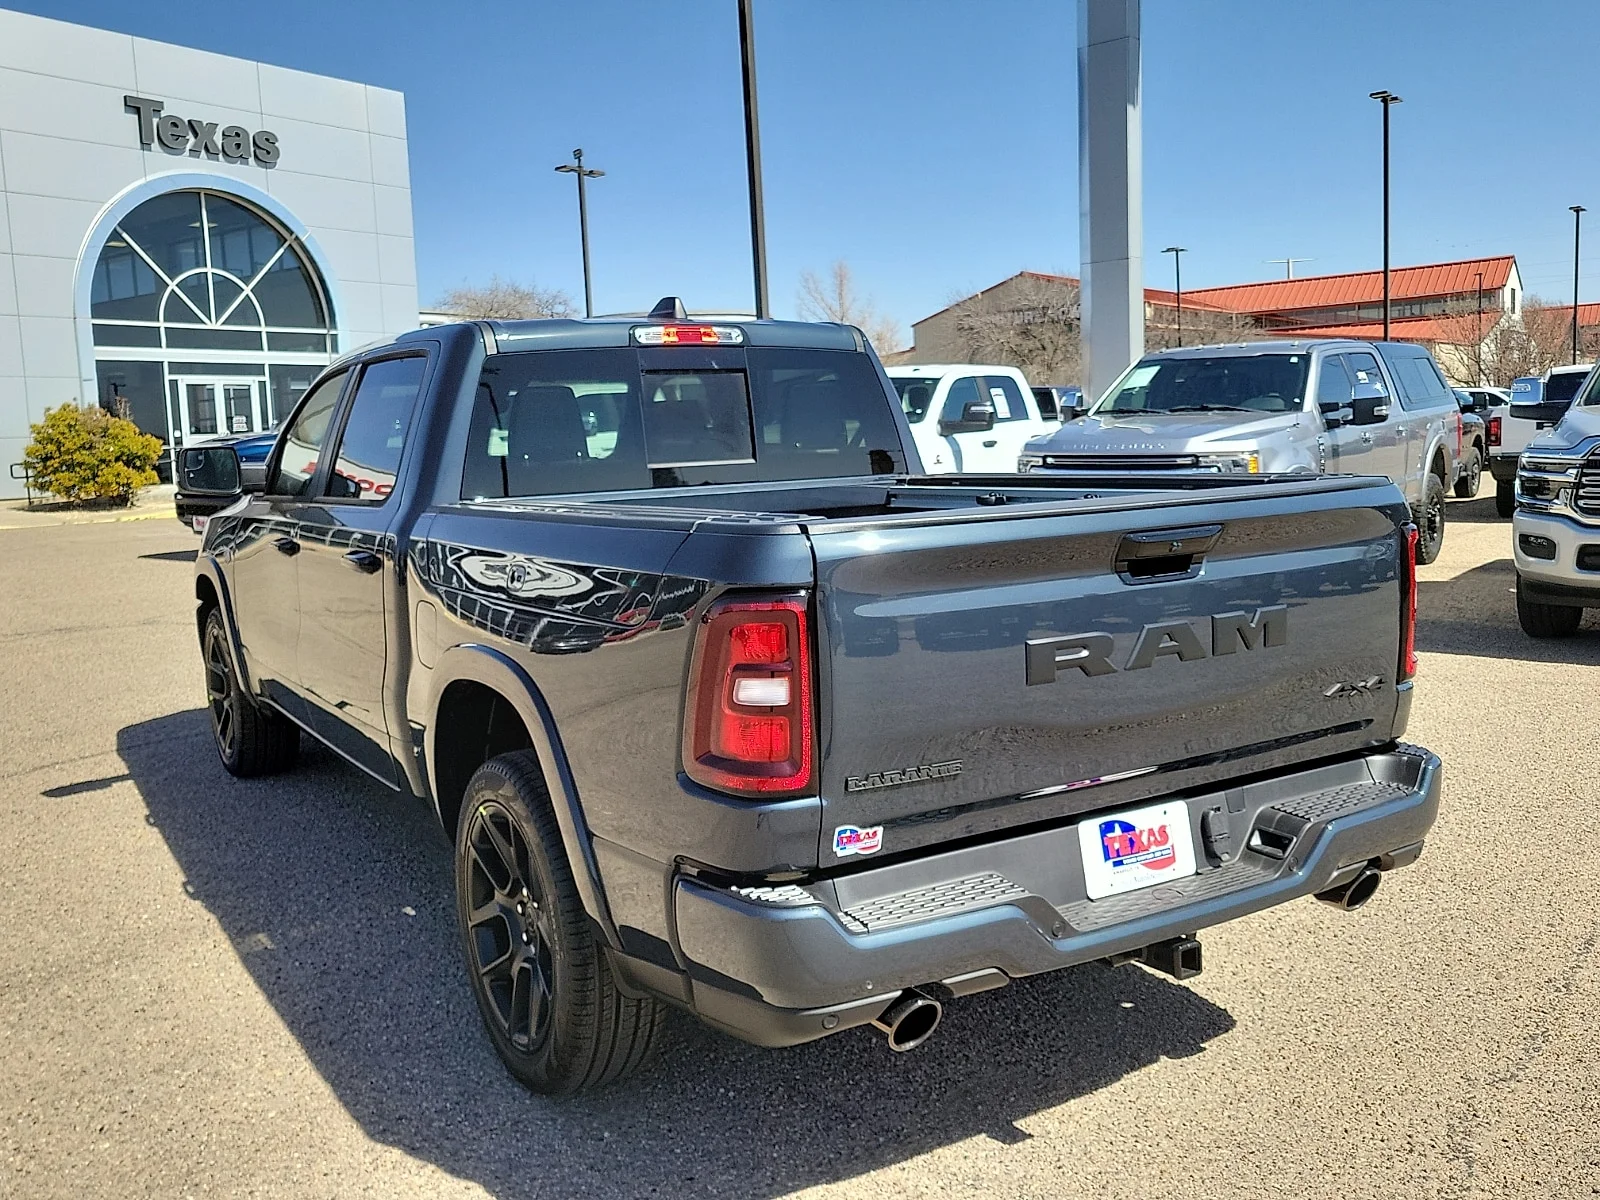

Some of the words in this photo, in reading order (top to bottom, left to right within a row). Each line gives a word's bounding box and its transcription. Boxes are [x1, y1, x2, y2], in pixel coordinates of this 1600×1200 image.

[123, 94, 280, 165] Texas
[1025, 604, 1287, 686] RAM
[837, 830, 879, 846] TEXAS
[1103, 825, 1169, 859] TEXAS
